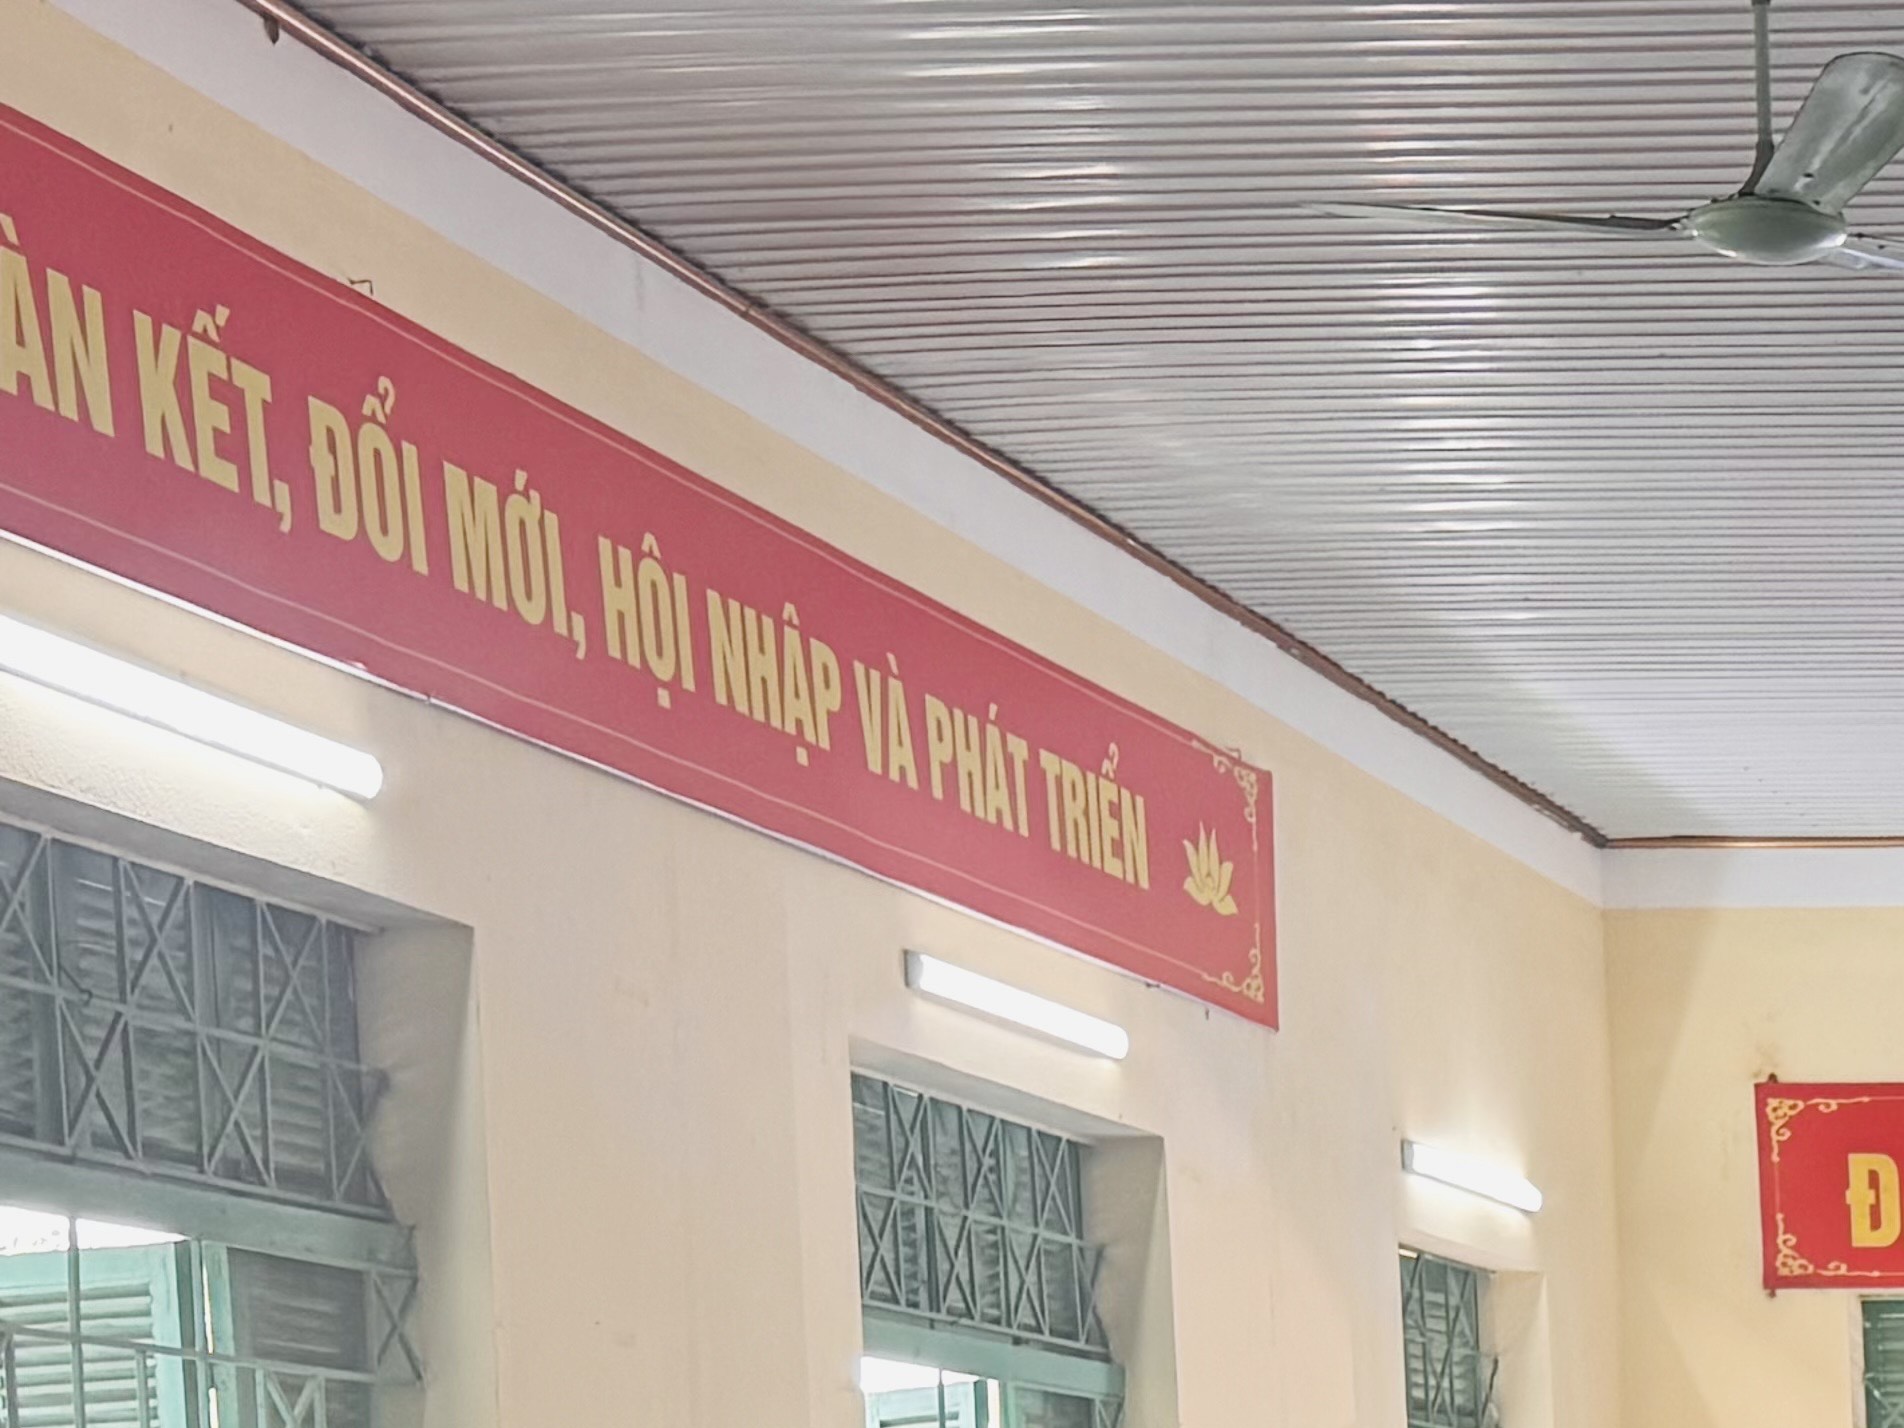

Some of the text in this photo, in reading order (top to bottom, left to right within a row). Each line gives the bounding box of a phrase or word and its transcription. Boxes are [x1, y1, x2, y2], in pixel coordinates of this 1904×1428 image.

[133, 305, 291, 533] KẾT,
[308, 377, 428, 576] ĐỔI
[444, 461, 586, 659] MỚI,
[599, 533, 695, 708] HỘI
[707, 592, 841, 766] NHẬP
[854, 653, 918, 790] VÀ
[925, 694, 1028, 837] PHÁT
[1040, 743, 1149, 890] TRIỂN
